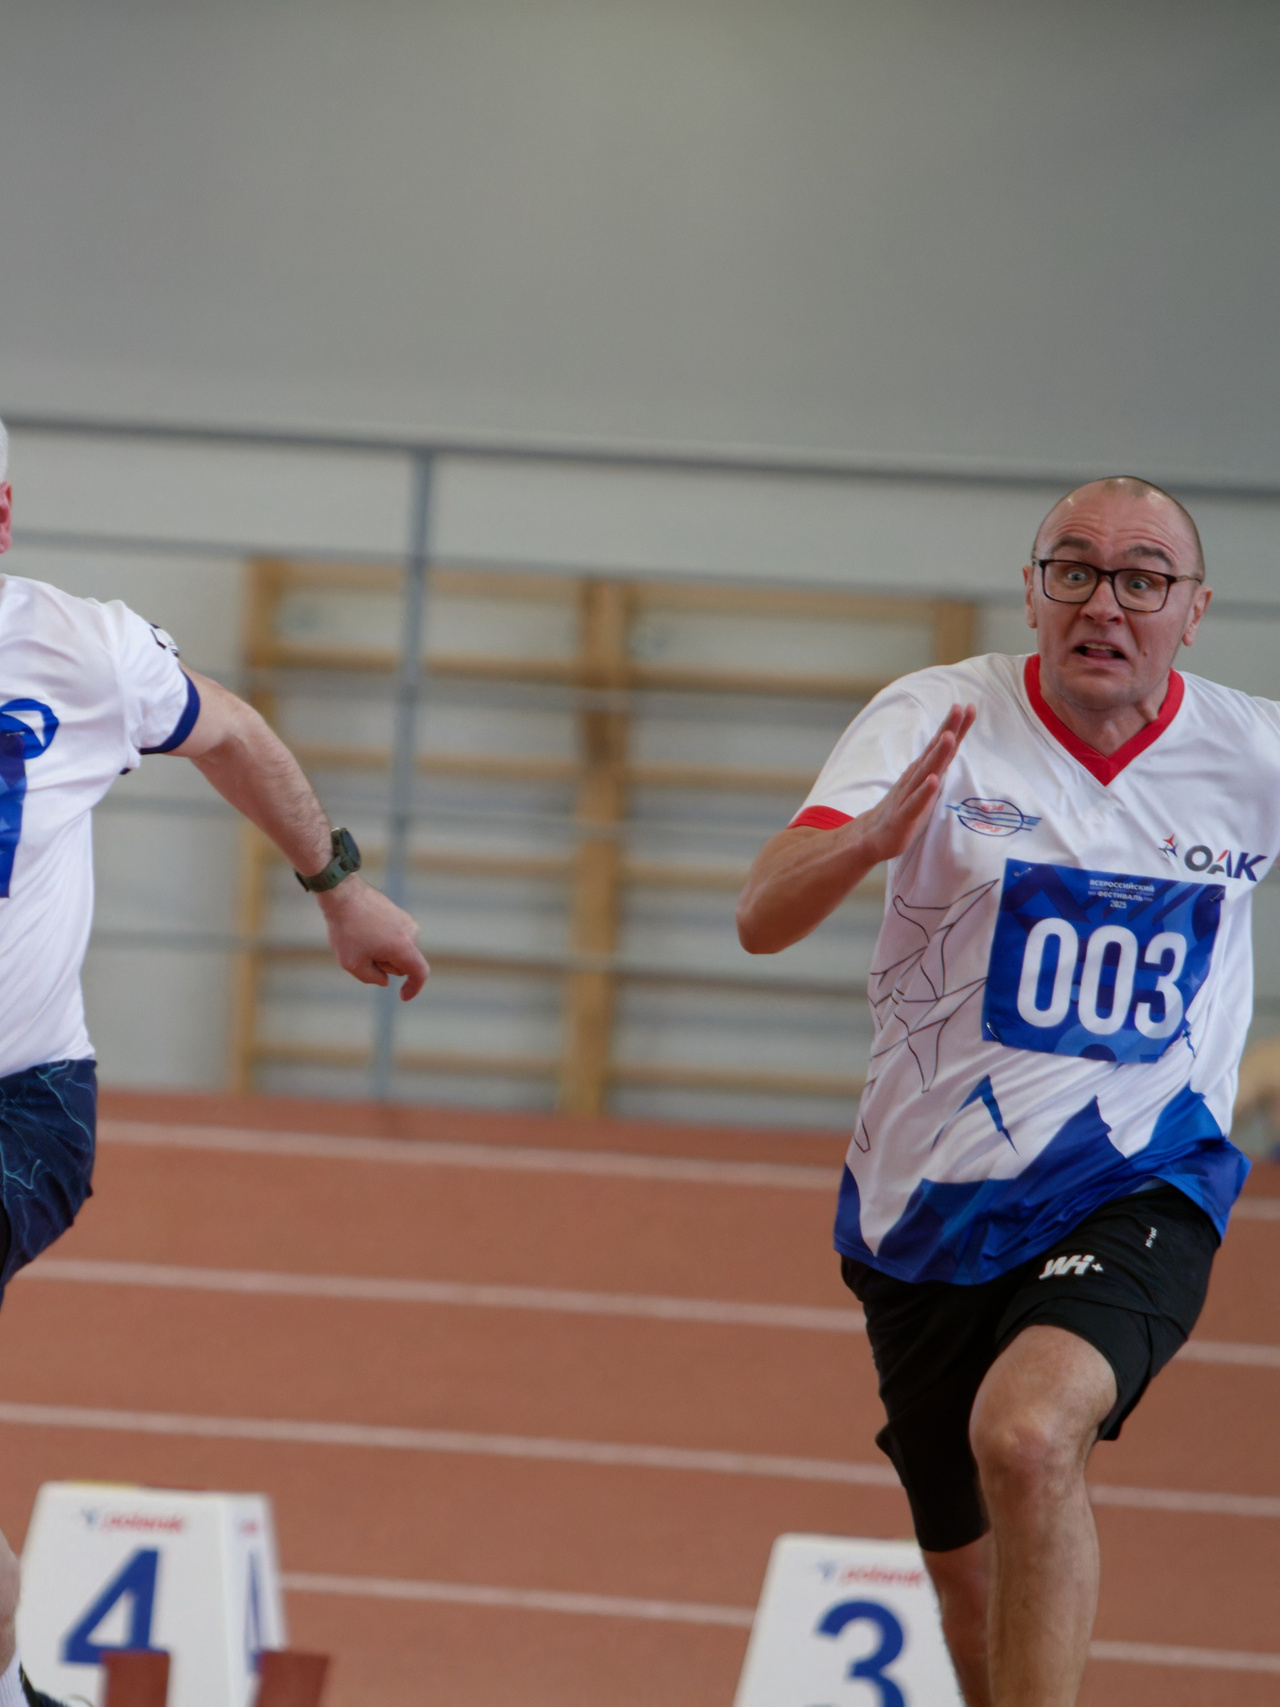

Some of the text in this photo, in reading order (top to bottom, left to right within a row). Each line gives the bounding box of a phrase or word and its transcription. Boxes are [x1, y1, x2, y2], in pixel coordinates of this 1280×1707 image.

[1089, 879, 1155, 893] ВСЕРОССИЙСКИЙ
[1097, 890, 1143, 902] ФЕСТИВАЛЬ
[1017, 917, 1188, 1040] 003
[61, 1546, 171, 1664] 4
[806, 1598, 905, 1707] 3
